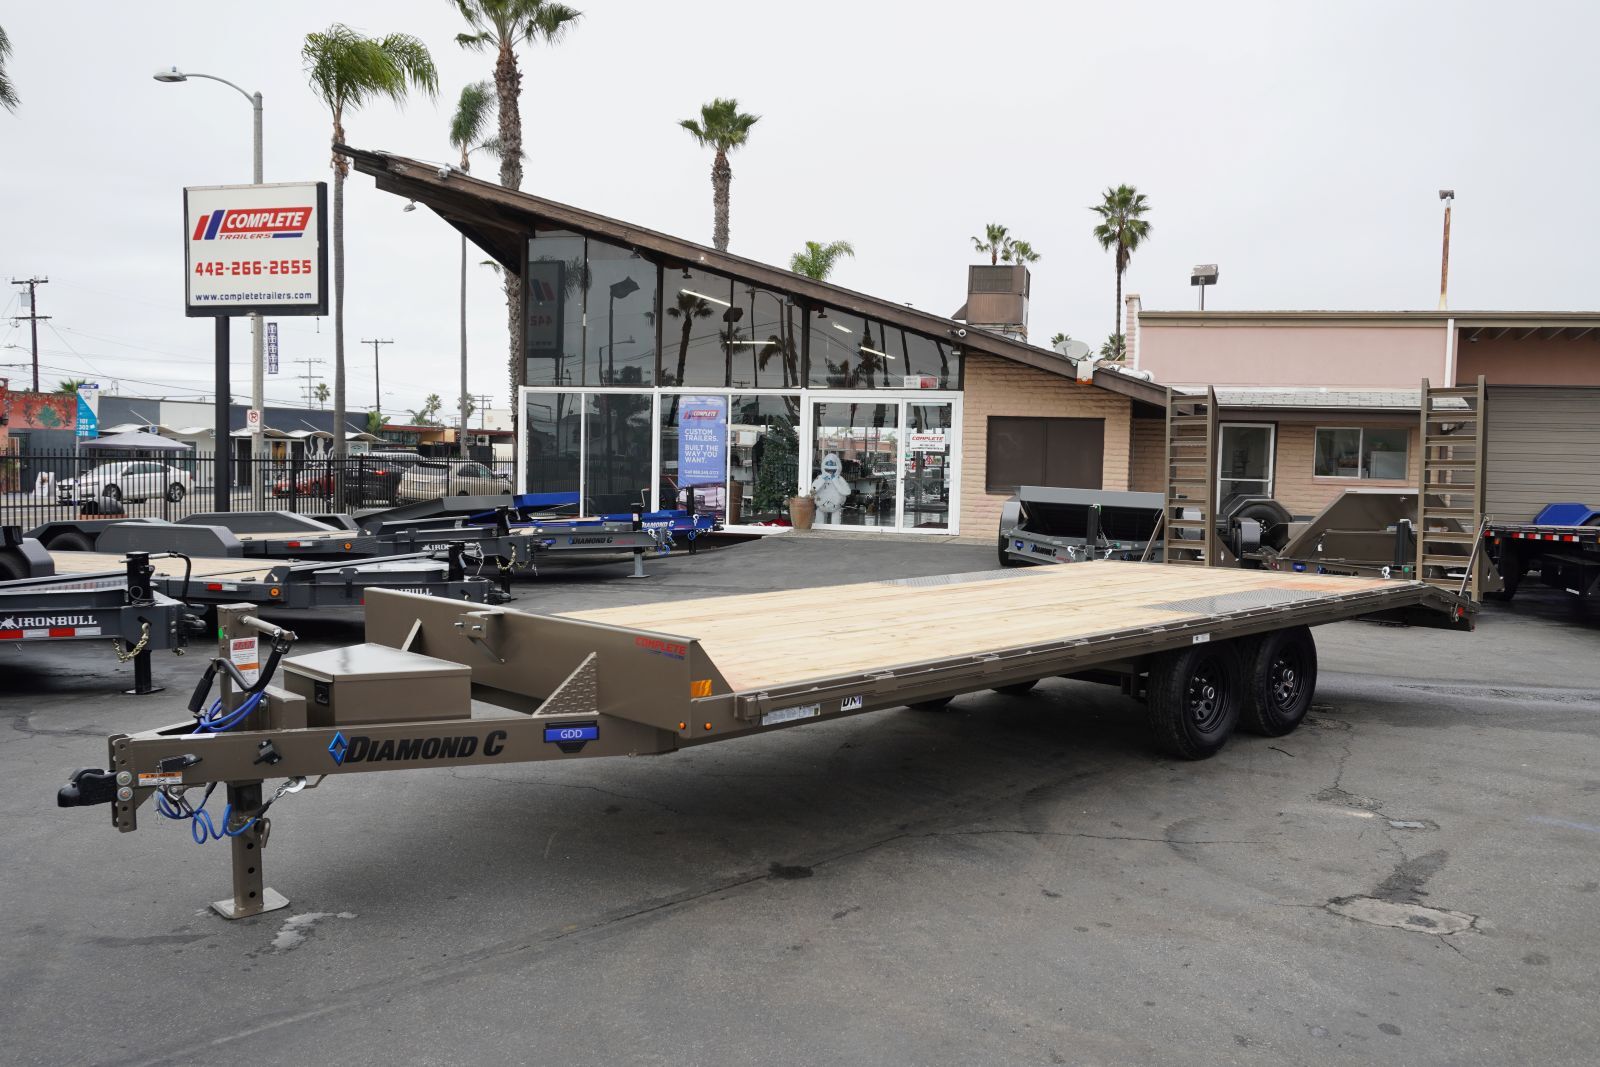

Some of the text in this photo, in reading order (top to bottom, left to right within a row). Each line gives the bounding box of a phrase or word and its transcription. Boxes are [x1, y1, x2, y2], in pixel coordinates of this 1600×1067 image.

[226, 211, 304, 229] COMPLETE
[195, 260, 312, 276] 442-266-2655
[196, 292, 312, 301] www.completetrailers.com
[17, 615, 98, 627] IRONBULL
[634, 636, 688, 656] COMPLETE
[560, 728, 583, 739] GDD
[343, 730, 508, 764] DIAMOND C
